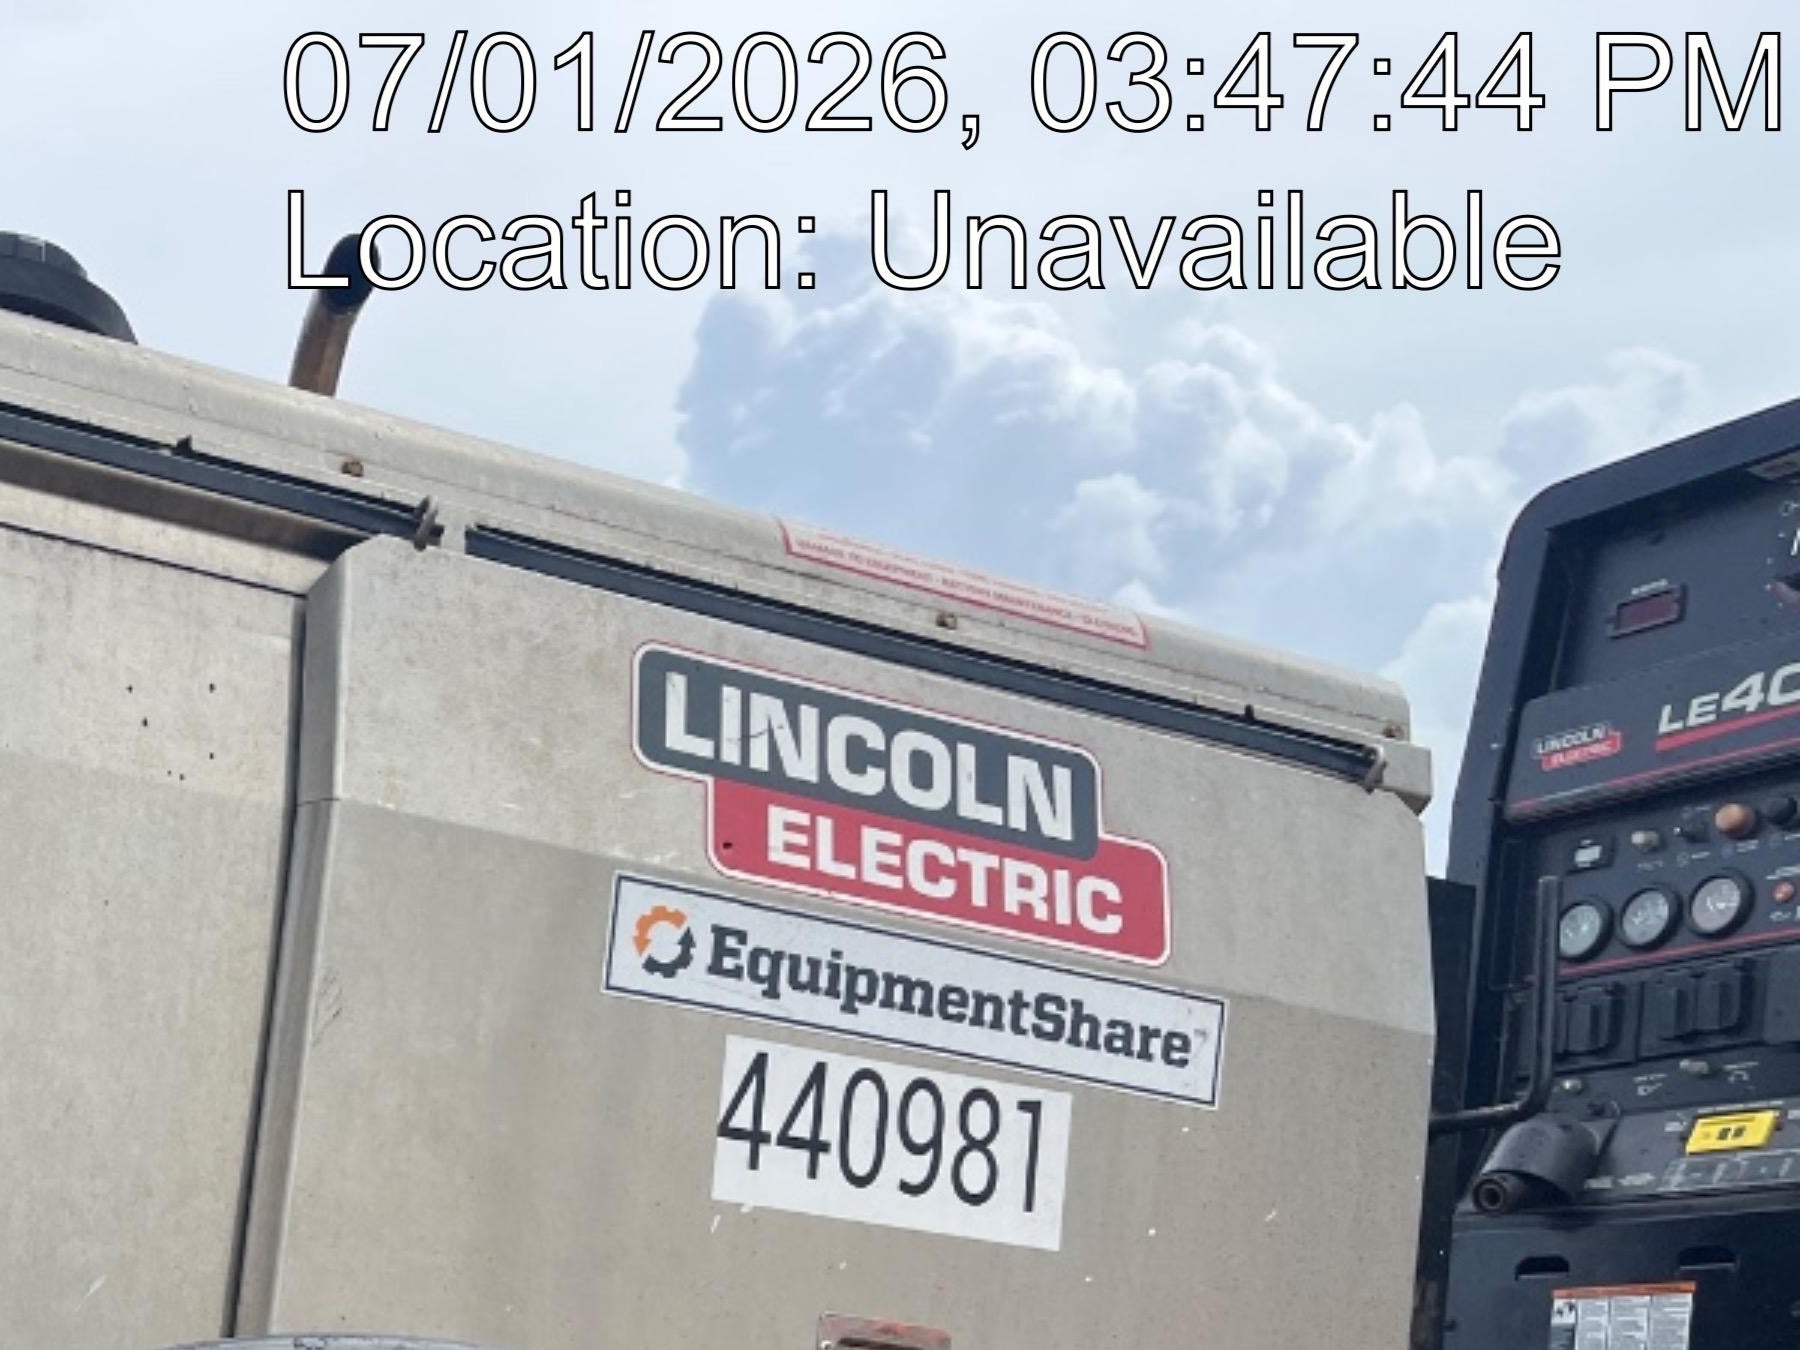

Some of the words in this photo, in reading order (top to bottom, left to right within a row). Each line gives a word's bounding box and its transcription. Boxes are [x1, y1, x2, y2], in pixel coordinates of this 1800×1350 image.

[663, 670, 1073, 842] LINCOLN
[766, 803, 1123, 936] ELECTRIC
[706, 924, 1193, 1069] EquipmentShare
[716, 1050, 1045, 1214] 440981
